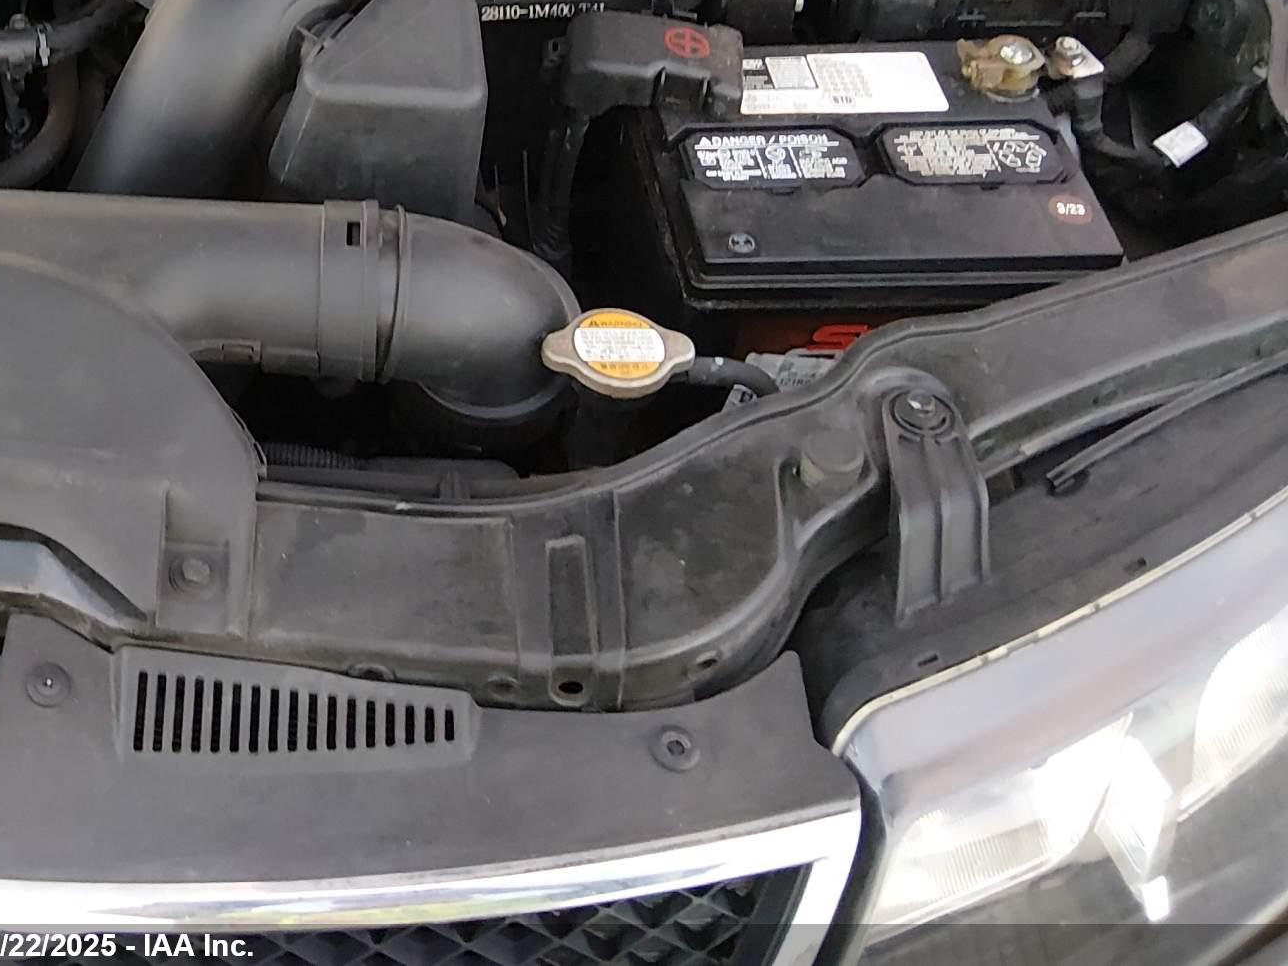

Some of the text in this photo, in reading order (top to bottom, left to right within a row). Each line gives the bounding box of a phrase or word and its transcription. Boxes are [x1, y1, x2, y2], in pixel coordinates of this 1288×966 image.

[481, 2, 575, 22] 28110-1M400
[711, 135, 766, 147] DANGER
[778, 134, 829, 146] POISON
